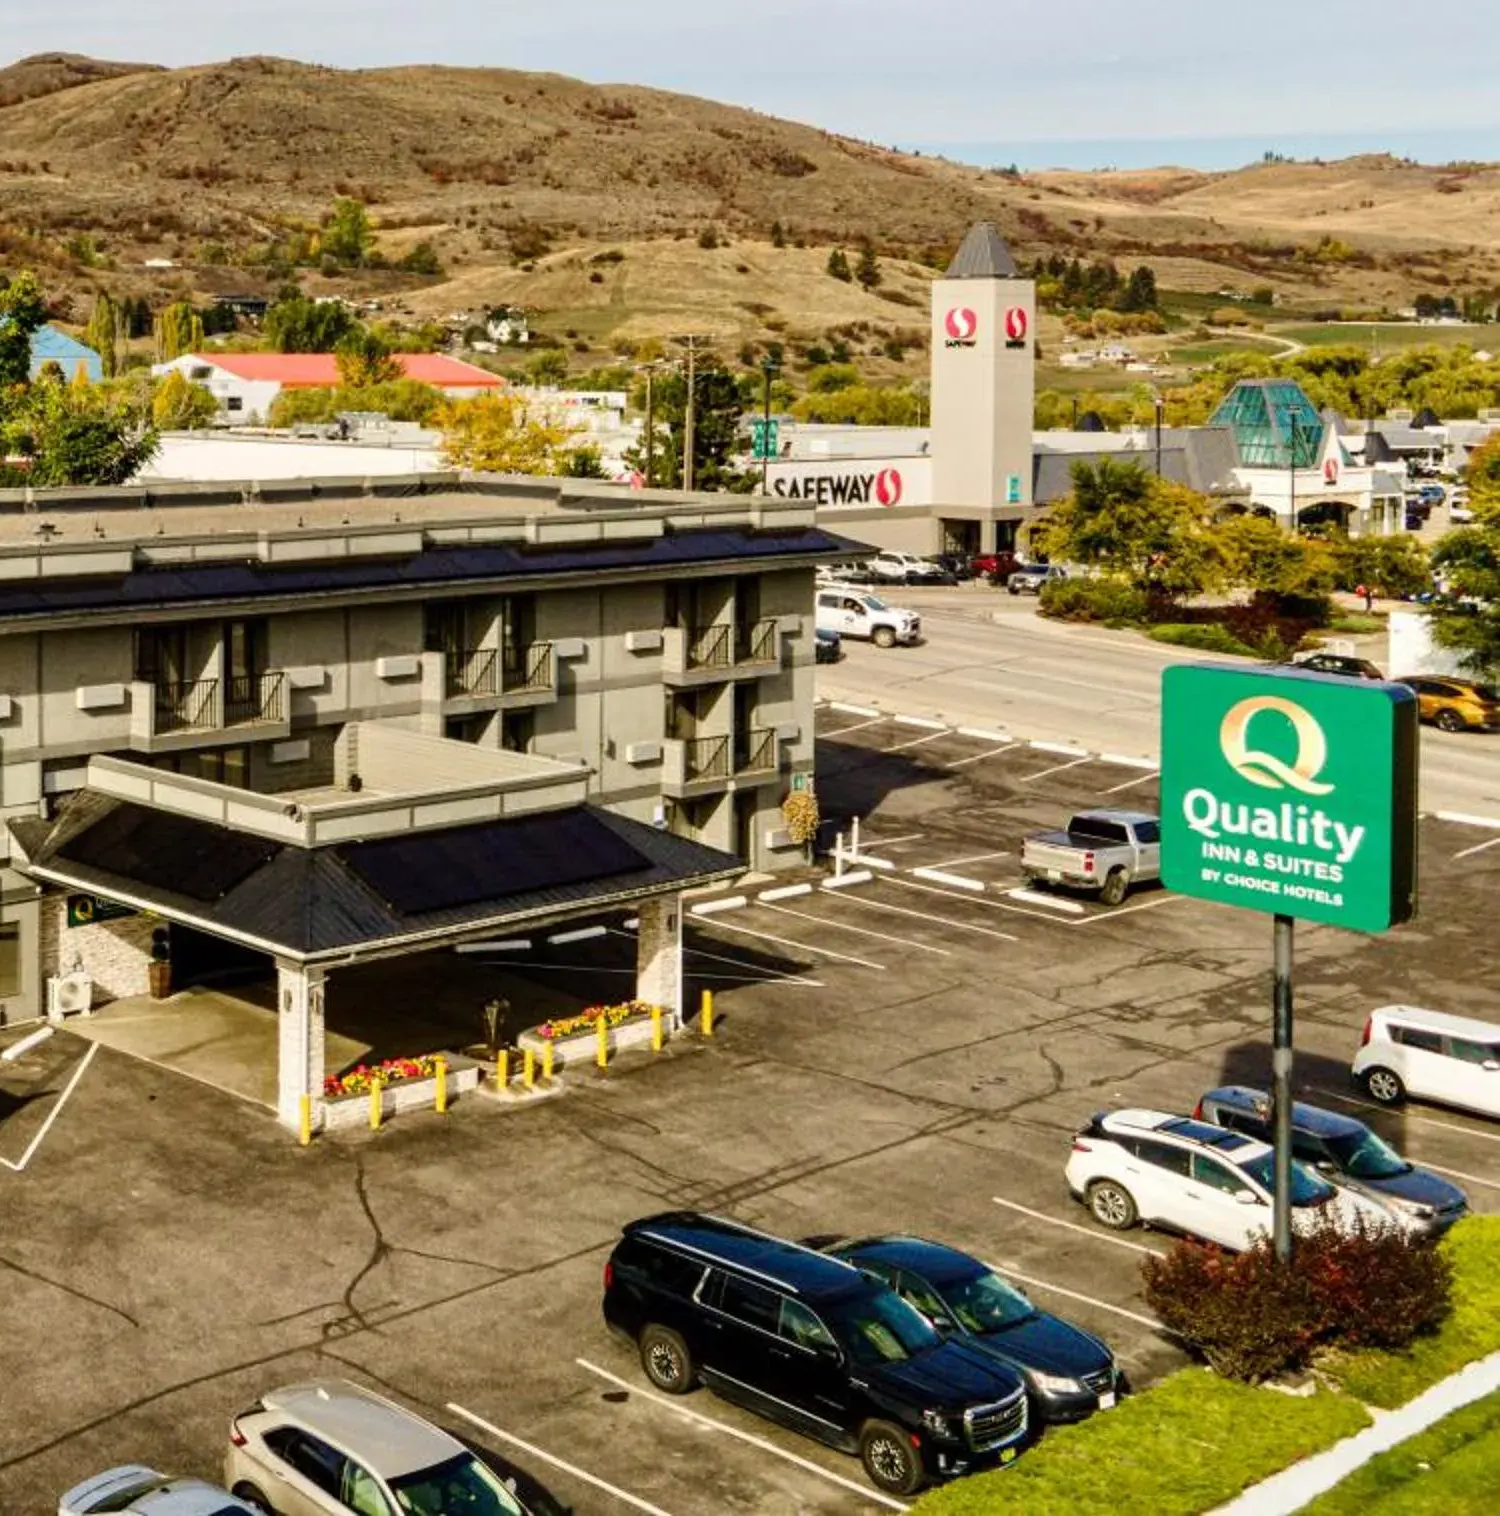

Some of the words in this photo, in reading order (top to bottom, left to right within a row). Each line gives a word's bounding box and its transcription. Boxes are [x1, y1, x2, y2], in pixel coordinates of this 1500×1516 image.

[774, 474, 875, 505] SAFEWAY
[1219, 695, 1336, 795] Q
[1183, 788, 1365, 863] Quality
[1202, 841, 1240, 864] INN
[1244, 849, 1260, 867] &
[1263, 852, 1344, 883] SUITES
[1201, 868, 1220, 882] BY
[1224, 873, 1281, 894] CHOICE
[1283, 883, 1344, 907] HOTELS
